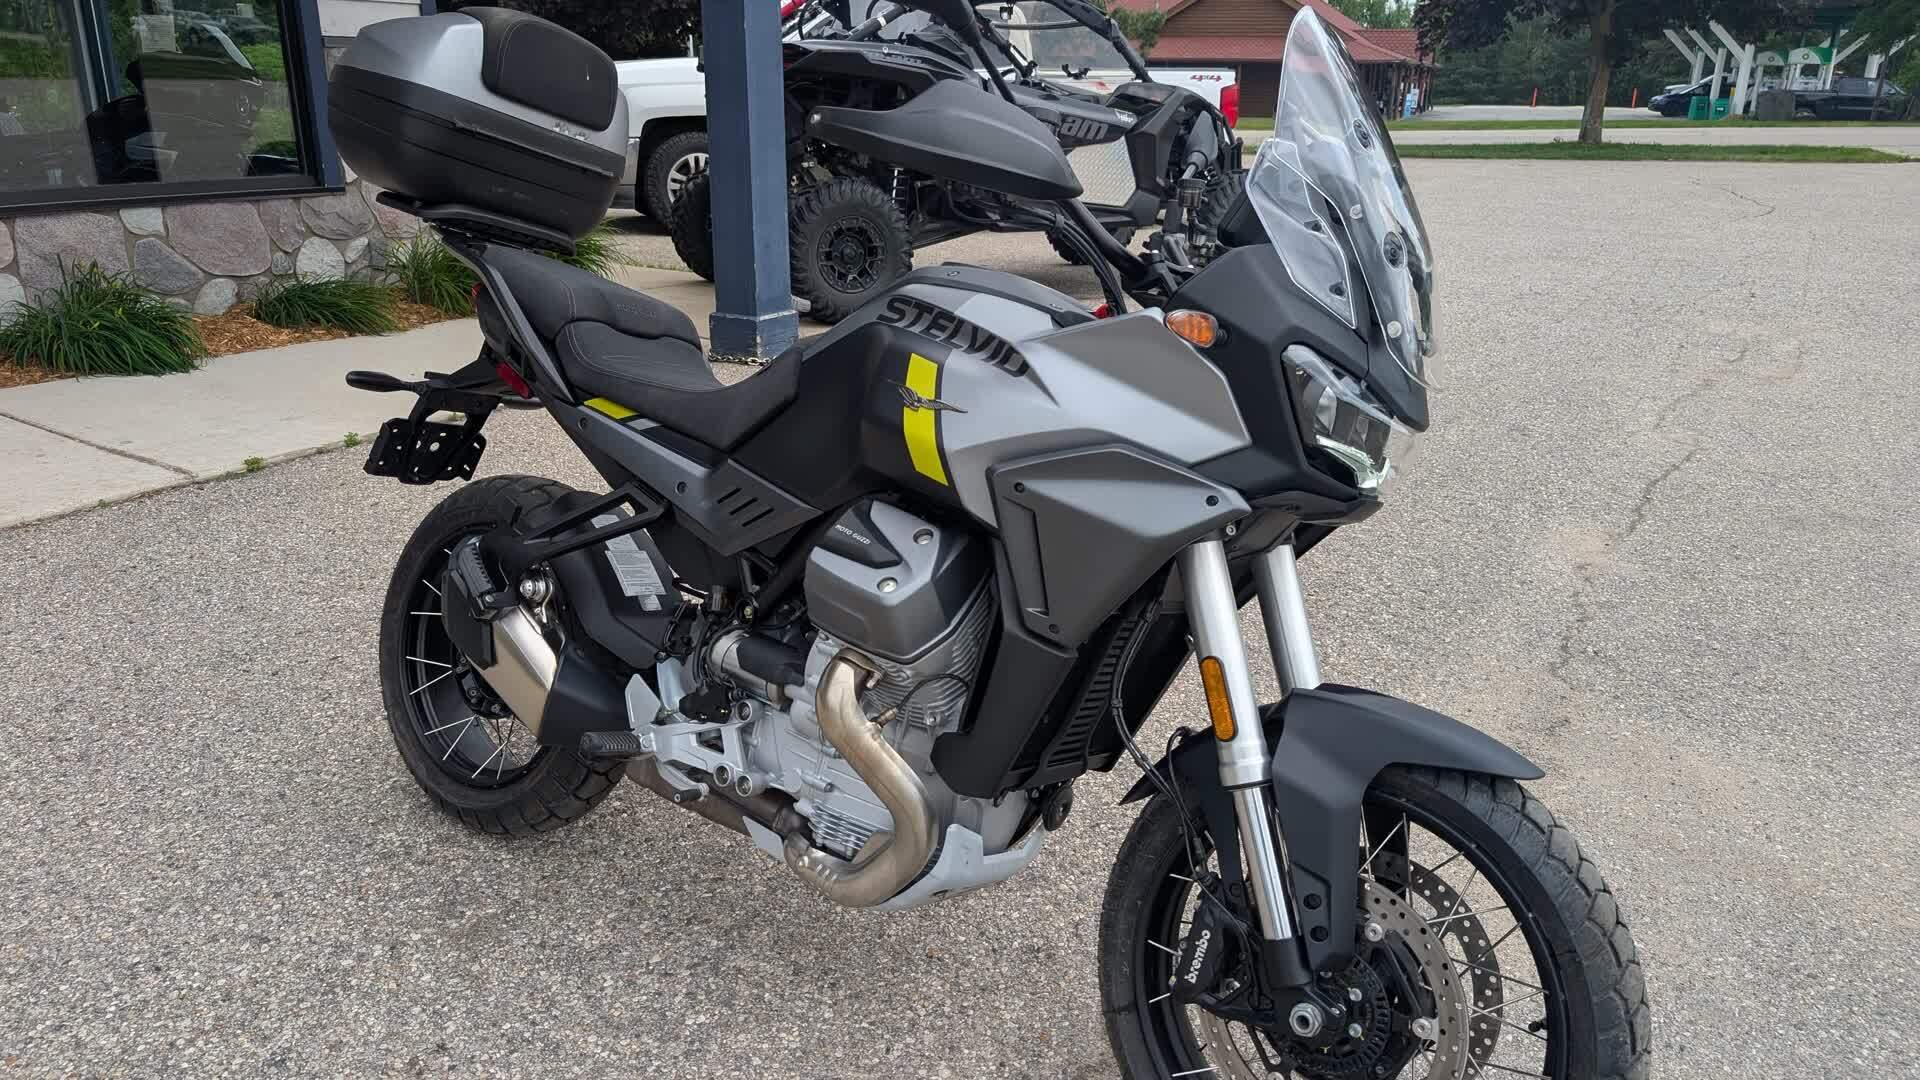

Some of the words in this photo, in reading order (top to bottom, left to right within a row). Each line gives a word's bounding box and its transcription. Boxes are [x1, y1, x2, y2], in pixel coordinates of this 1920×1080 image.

[835, 524, 853, 535] MOTO
[853, 533, 871, 545] GUZZI
[1184, 929, 1211, 984] brembo
